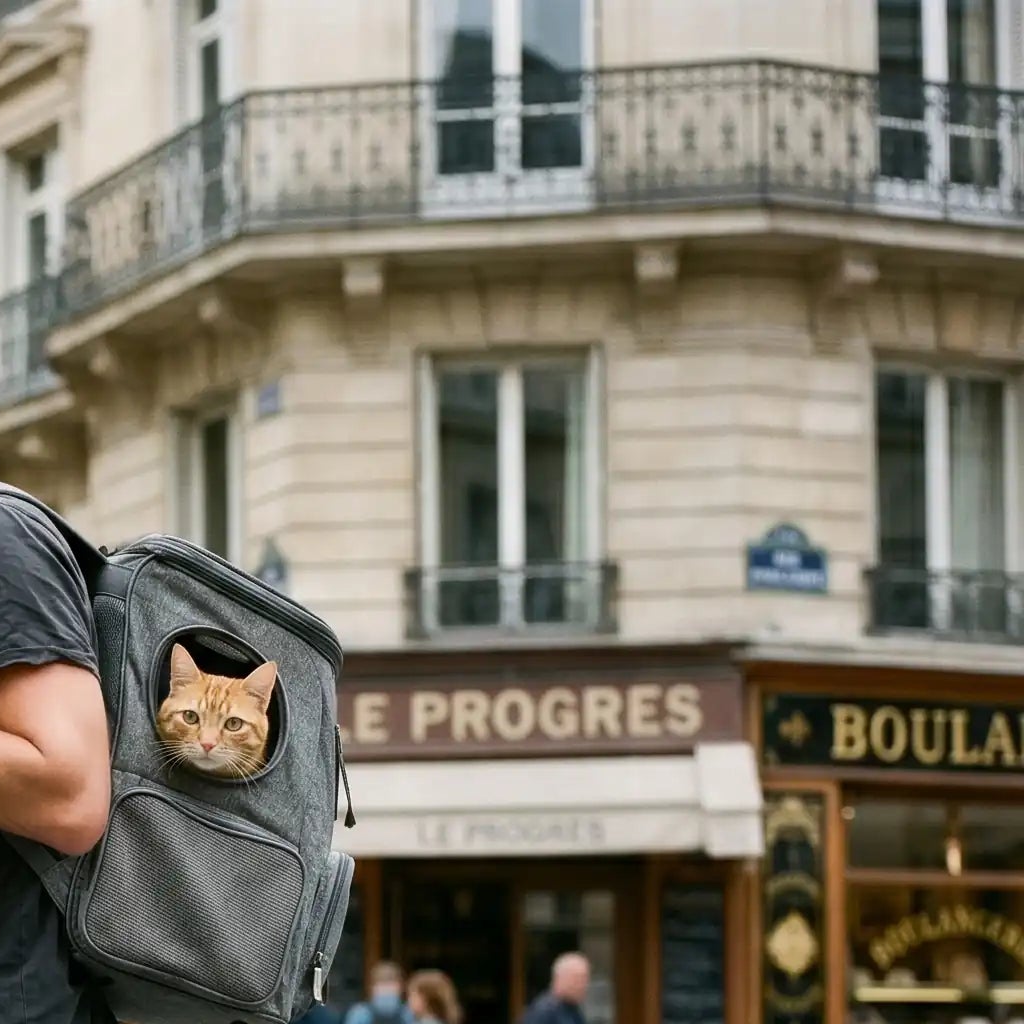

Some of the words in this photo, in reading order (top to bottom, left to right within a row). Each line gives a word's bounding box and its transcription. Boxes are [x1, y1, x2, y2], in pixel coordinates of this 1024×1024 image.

[340, 691, 390, 744] E
[410, 683, 703, 744] PROGRES
[830, 703, 1024, 767] BOULA
